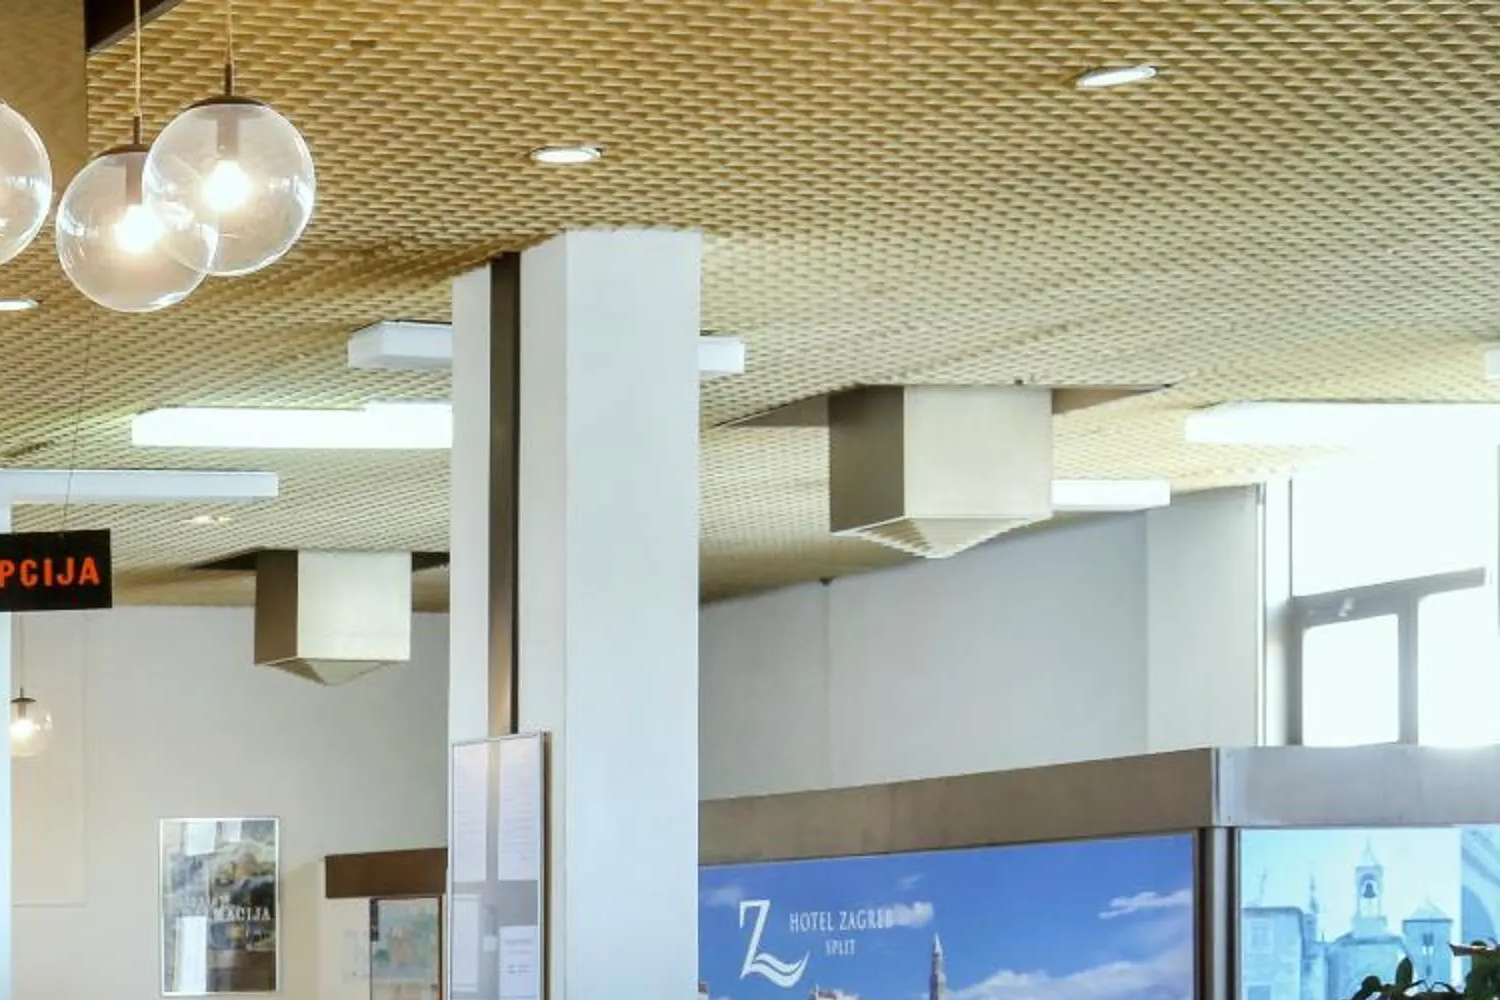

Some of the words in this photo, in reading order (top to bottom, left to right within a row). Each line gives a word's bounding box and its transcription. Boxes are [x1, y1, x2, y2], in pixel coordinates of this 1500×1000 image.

[789, 910, 834, 933] HOTEL
[839, 908, 893, 931] ZAGREB
[825, 939, 856, 956] SPLIT
